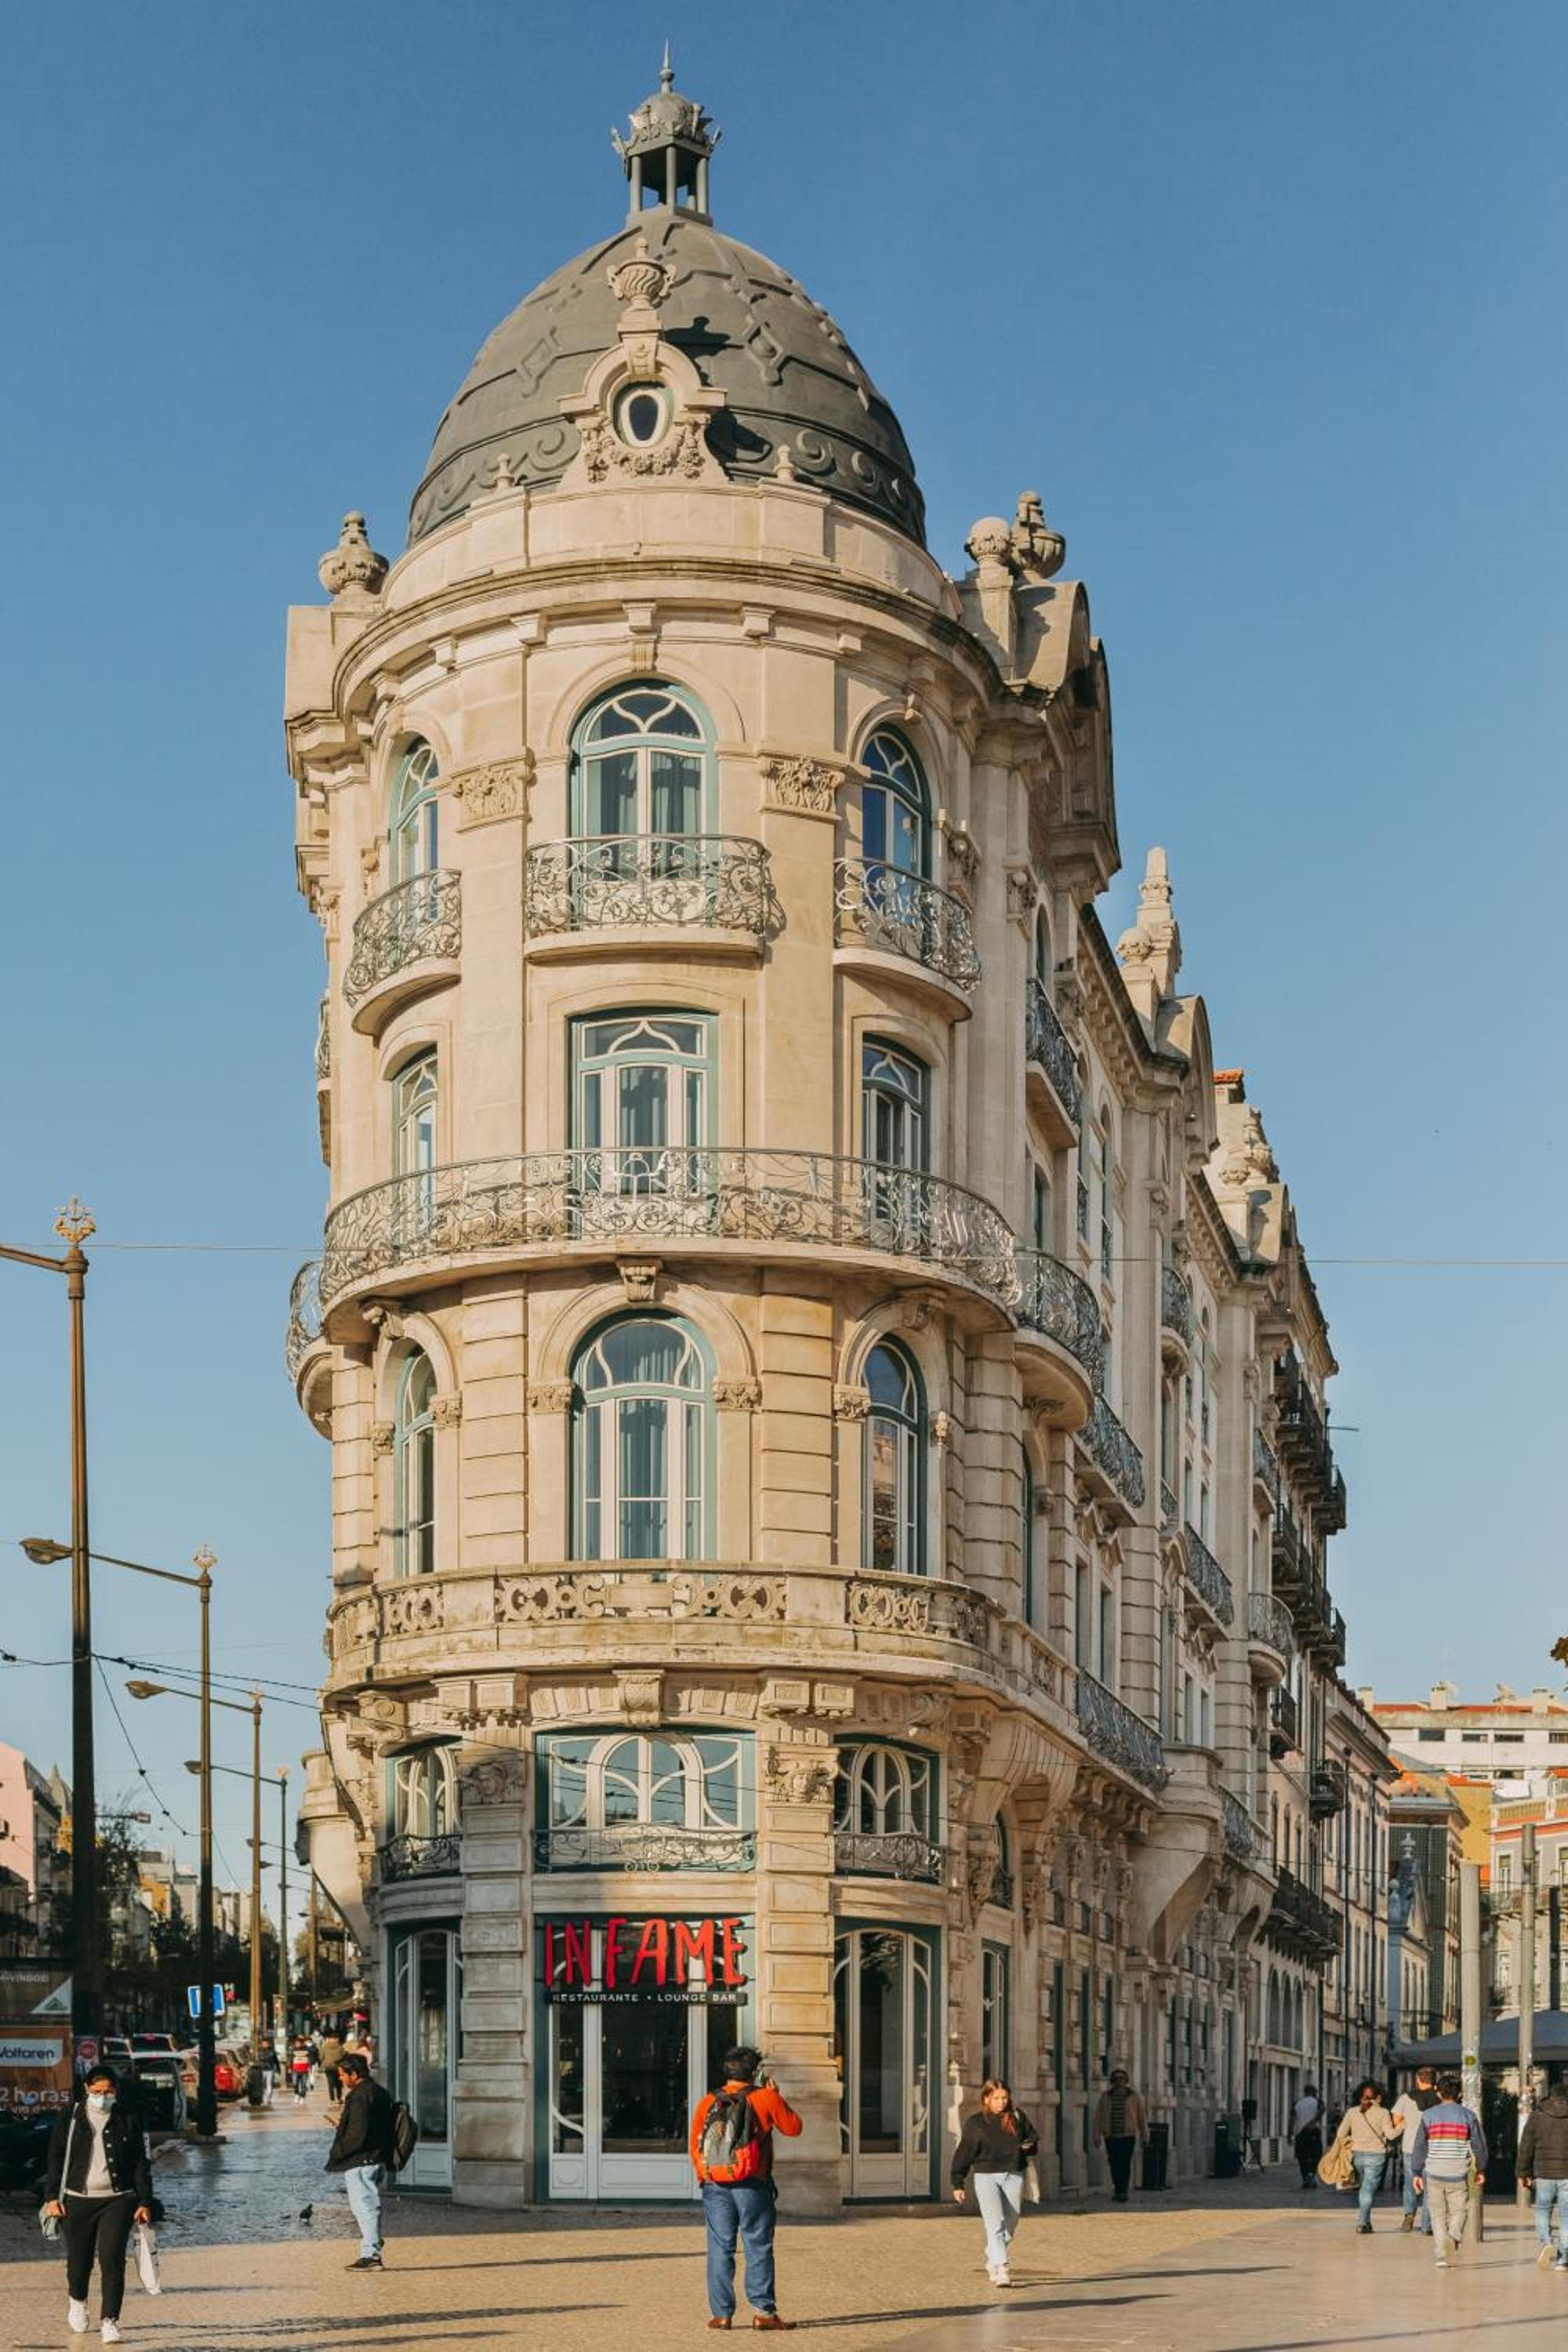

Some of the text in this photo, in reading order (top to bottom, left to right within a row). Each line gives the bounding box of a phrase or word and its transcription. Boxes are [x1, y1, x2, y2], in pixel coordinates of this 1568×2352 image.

[544, 1918, 746, 1988] INFAME
[552, 1994, 737, 2002] RESTAURANTE LOUNGE BAR
[0, 2047, 54, 2059] Voltaren
[14, 2085, 69, 2103] horas
